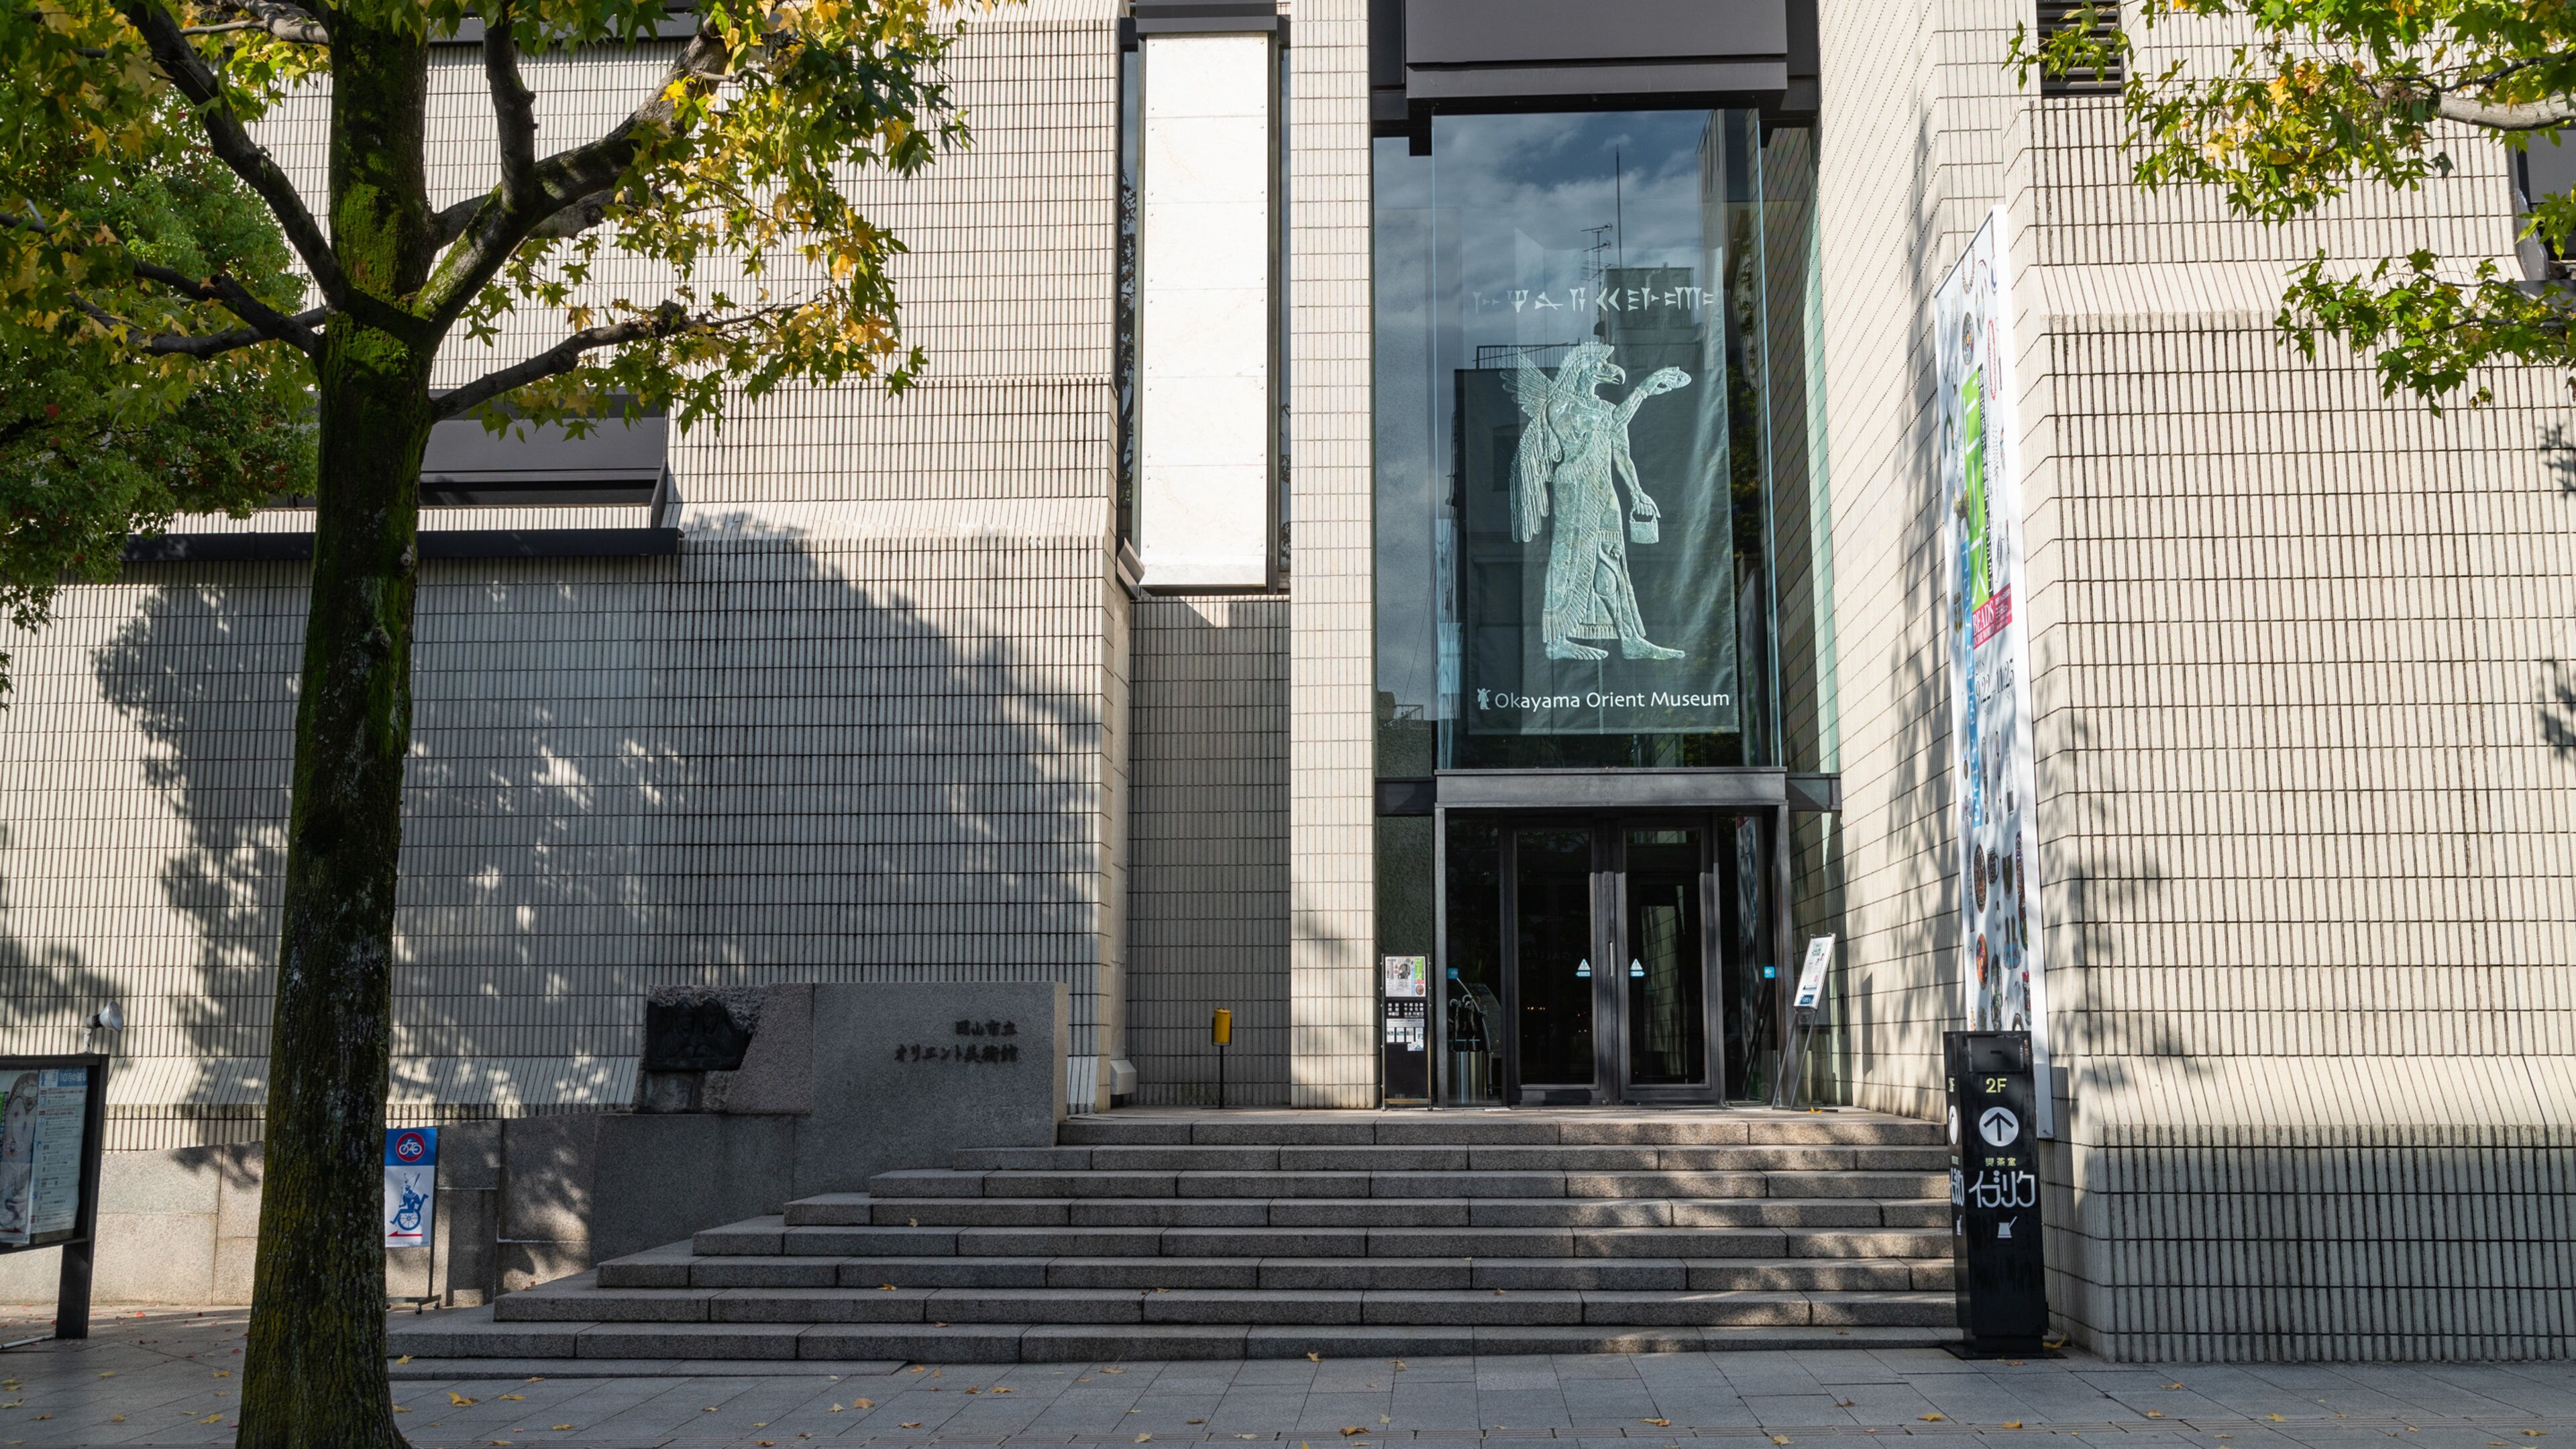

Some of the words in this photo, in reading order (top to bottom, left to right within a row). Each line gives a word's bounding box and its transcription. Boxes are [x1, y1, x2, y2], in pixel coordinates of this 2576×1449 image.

[1972, 600, 1994, 635] BEADS
[1495, 692, 1580, 712] Okayama
[1586, 692, 1645, 707] Orient
[1650, 692, 1729, 707] Museum
[955, 1019, 1018, 1036] 岡山市立
[894, 1043, 1018, 1063] オリエント美術館
[1986, 1077, 2007, 1093] 2F
[1985, 1157, 2017, 1167] 喫茶室
